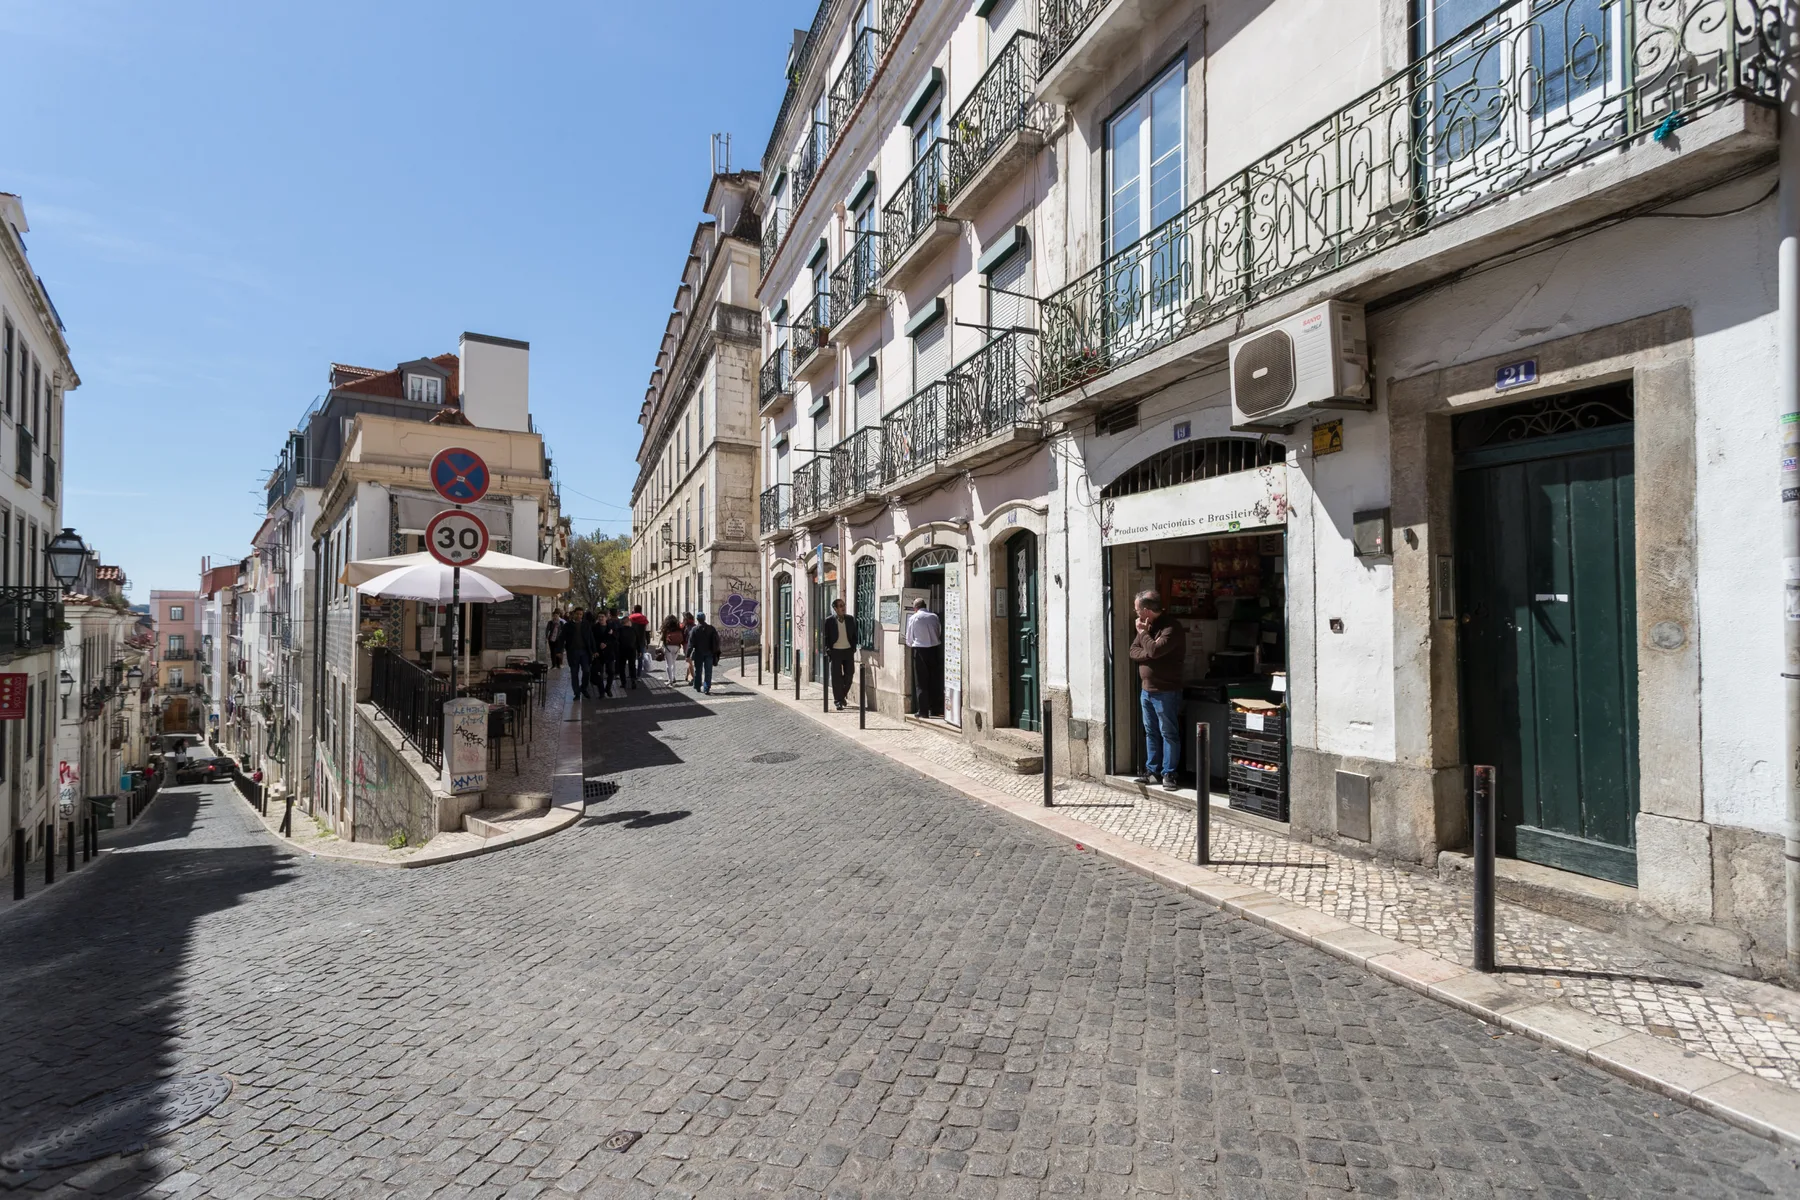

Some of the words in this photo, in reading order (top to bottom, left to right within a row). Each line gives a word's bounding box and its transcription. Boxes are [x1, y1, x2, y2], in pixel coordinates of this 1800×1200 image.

[1303, 314, 1321, 326] SANYO
[1504, 364, 1527, 384] 21
[1114, 526, 1149, 536] Produtos
[1152, 518, 1196, 531] Nacionais
[1198, 517, 1205, 525] e
[1208, 508, 1264, 522] Brasileiro
[437, 526, 479, 550] 30
